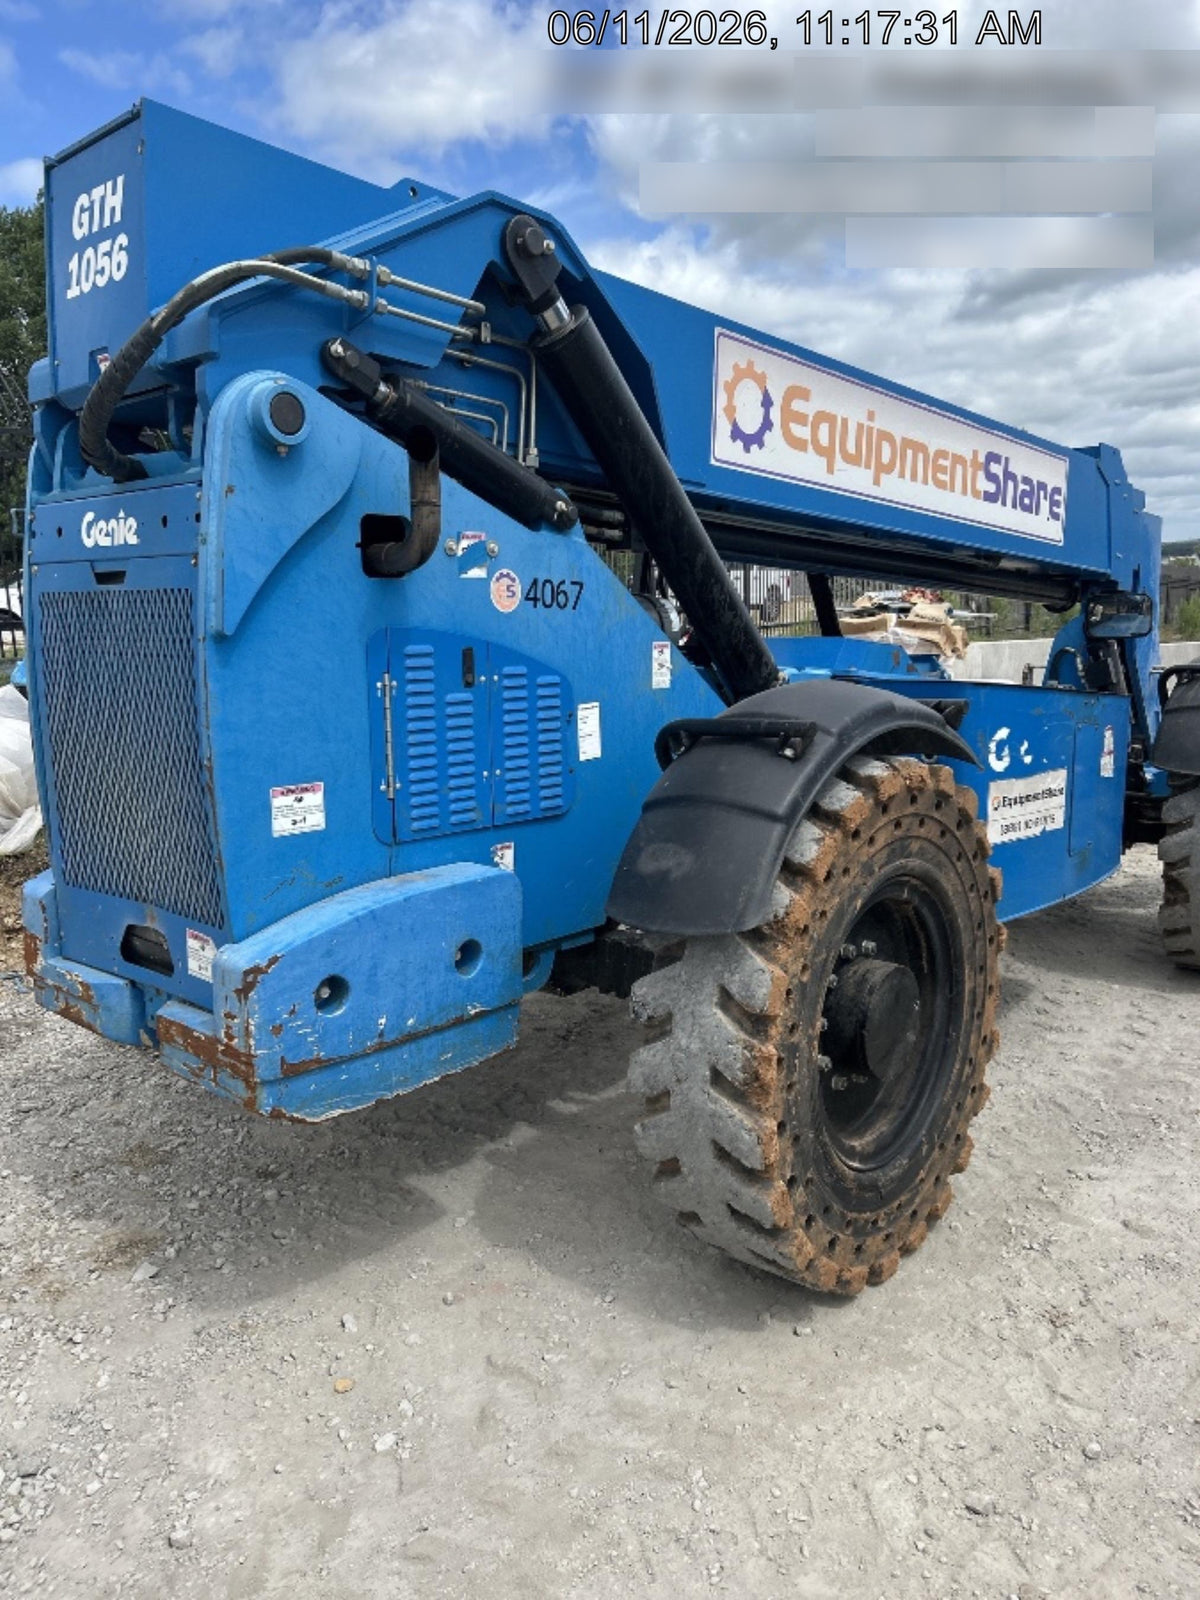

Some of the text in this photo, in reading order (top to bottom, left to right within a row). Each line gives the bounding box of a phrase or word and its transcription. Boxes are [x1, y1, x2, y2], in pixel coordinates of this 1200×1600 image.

[72, 174, 125, 241] GTH
[66, 232, 129, 299] 1056
[780, 384, 1064, 523] EquipmentShare
[81, 508, 138, 548] Genie
[524, 577, 584, 610] 4067
